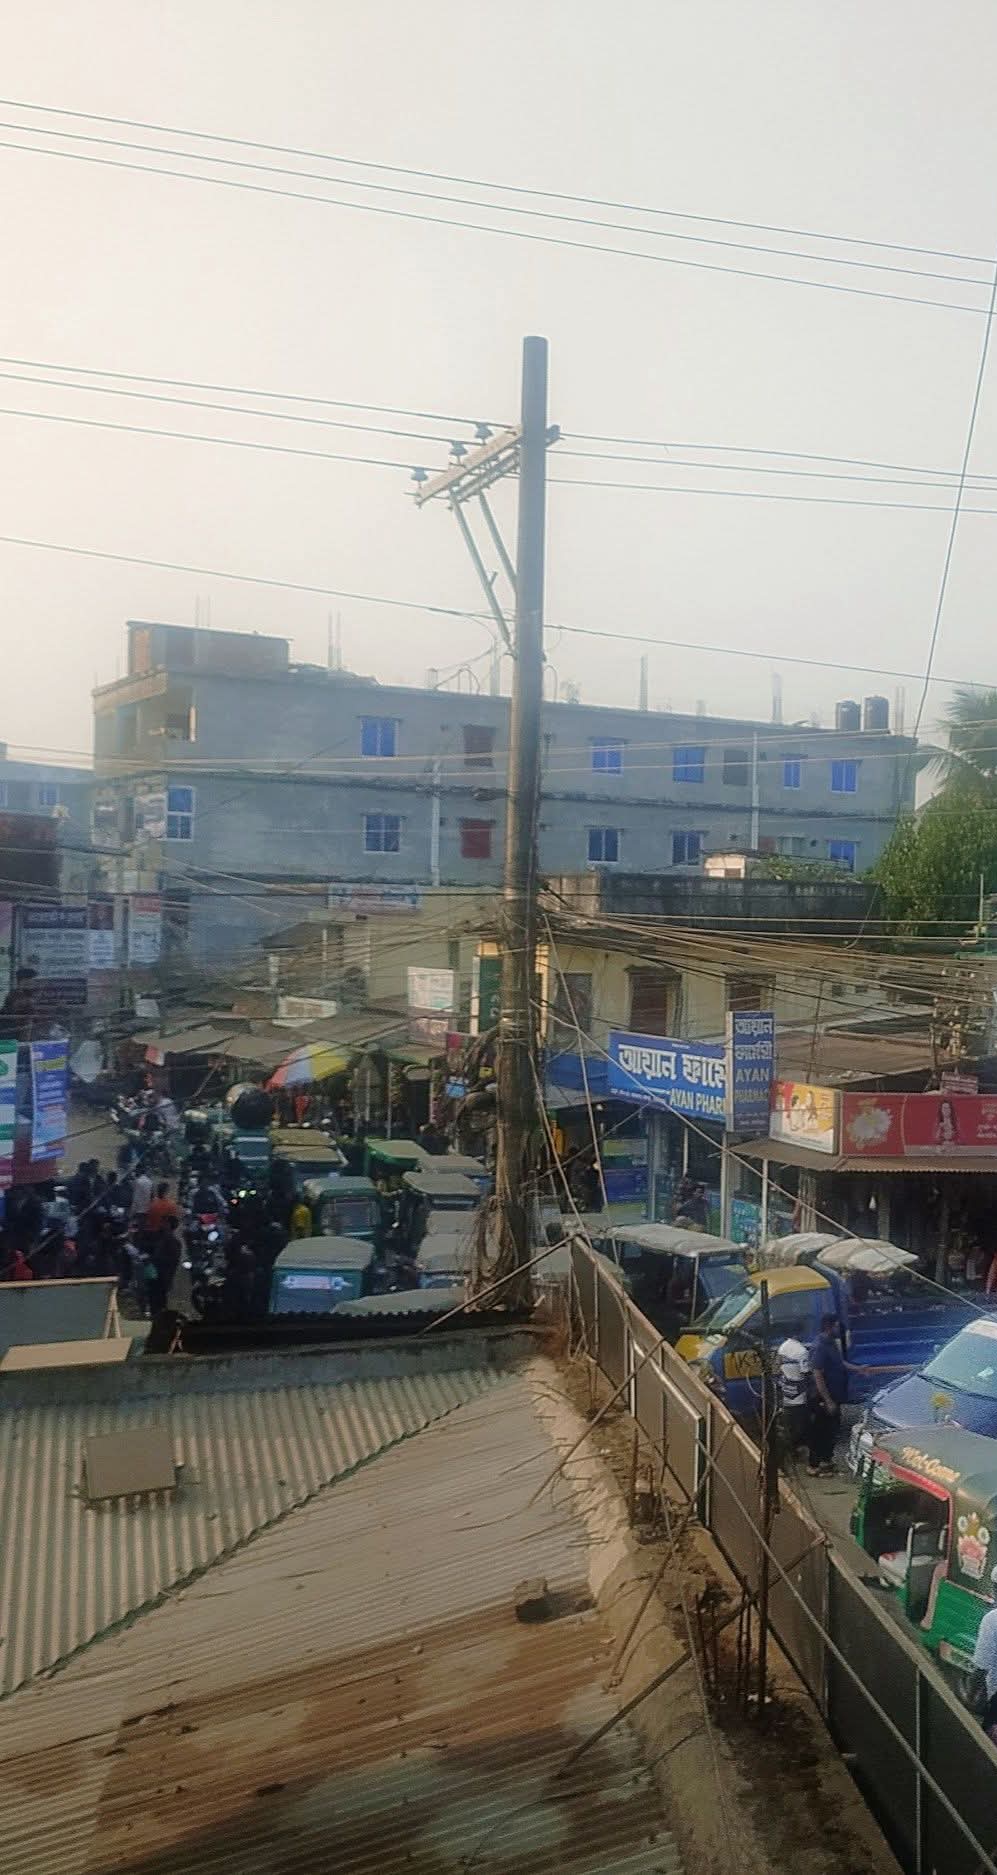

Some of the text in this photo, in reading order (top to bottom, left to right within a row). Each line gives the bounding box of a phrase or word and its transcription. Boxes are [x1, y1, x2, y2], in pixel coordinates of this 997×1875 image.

[618, 1044, 677, 1080] আয়ান
[736, 1068, 769, 1082] AYAN
[669, 1087, 694, 1110] AYAN
